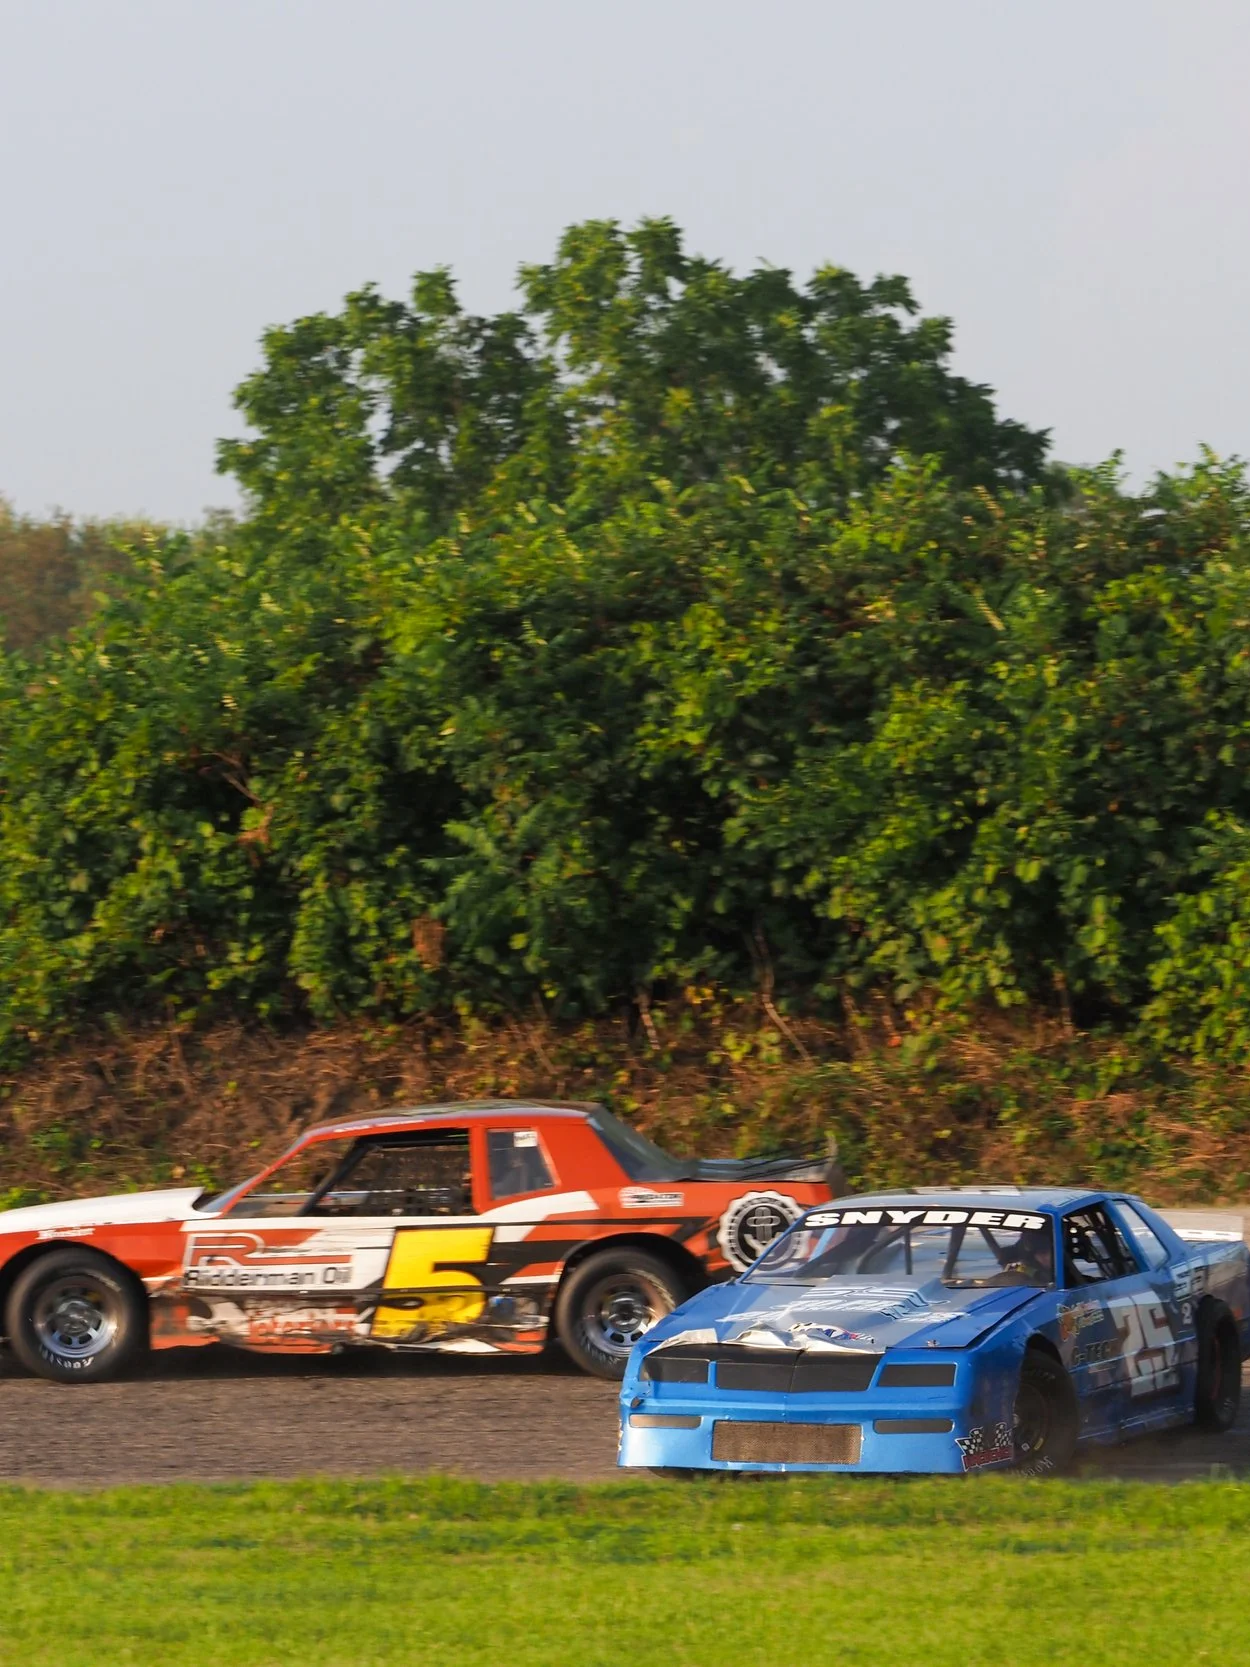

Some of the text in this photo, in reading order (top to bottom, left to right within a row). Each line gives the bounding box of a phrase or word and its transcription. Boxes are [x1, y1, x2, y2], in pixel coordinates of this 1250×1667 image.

[804, 1209, 1047, 1231] SNYDER
[371, 1227, 494, 1338] 5
[1106, 1289, 1181, 1398] 25
